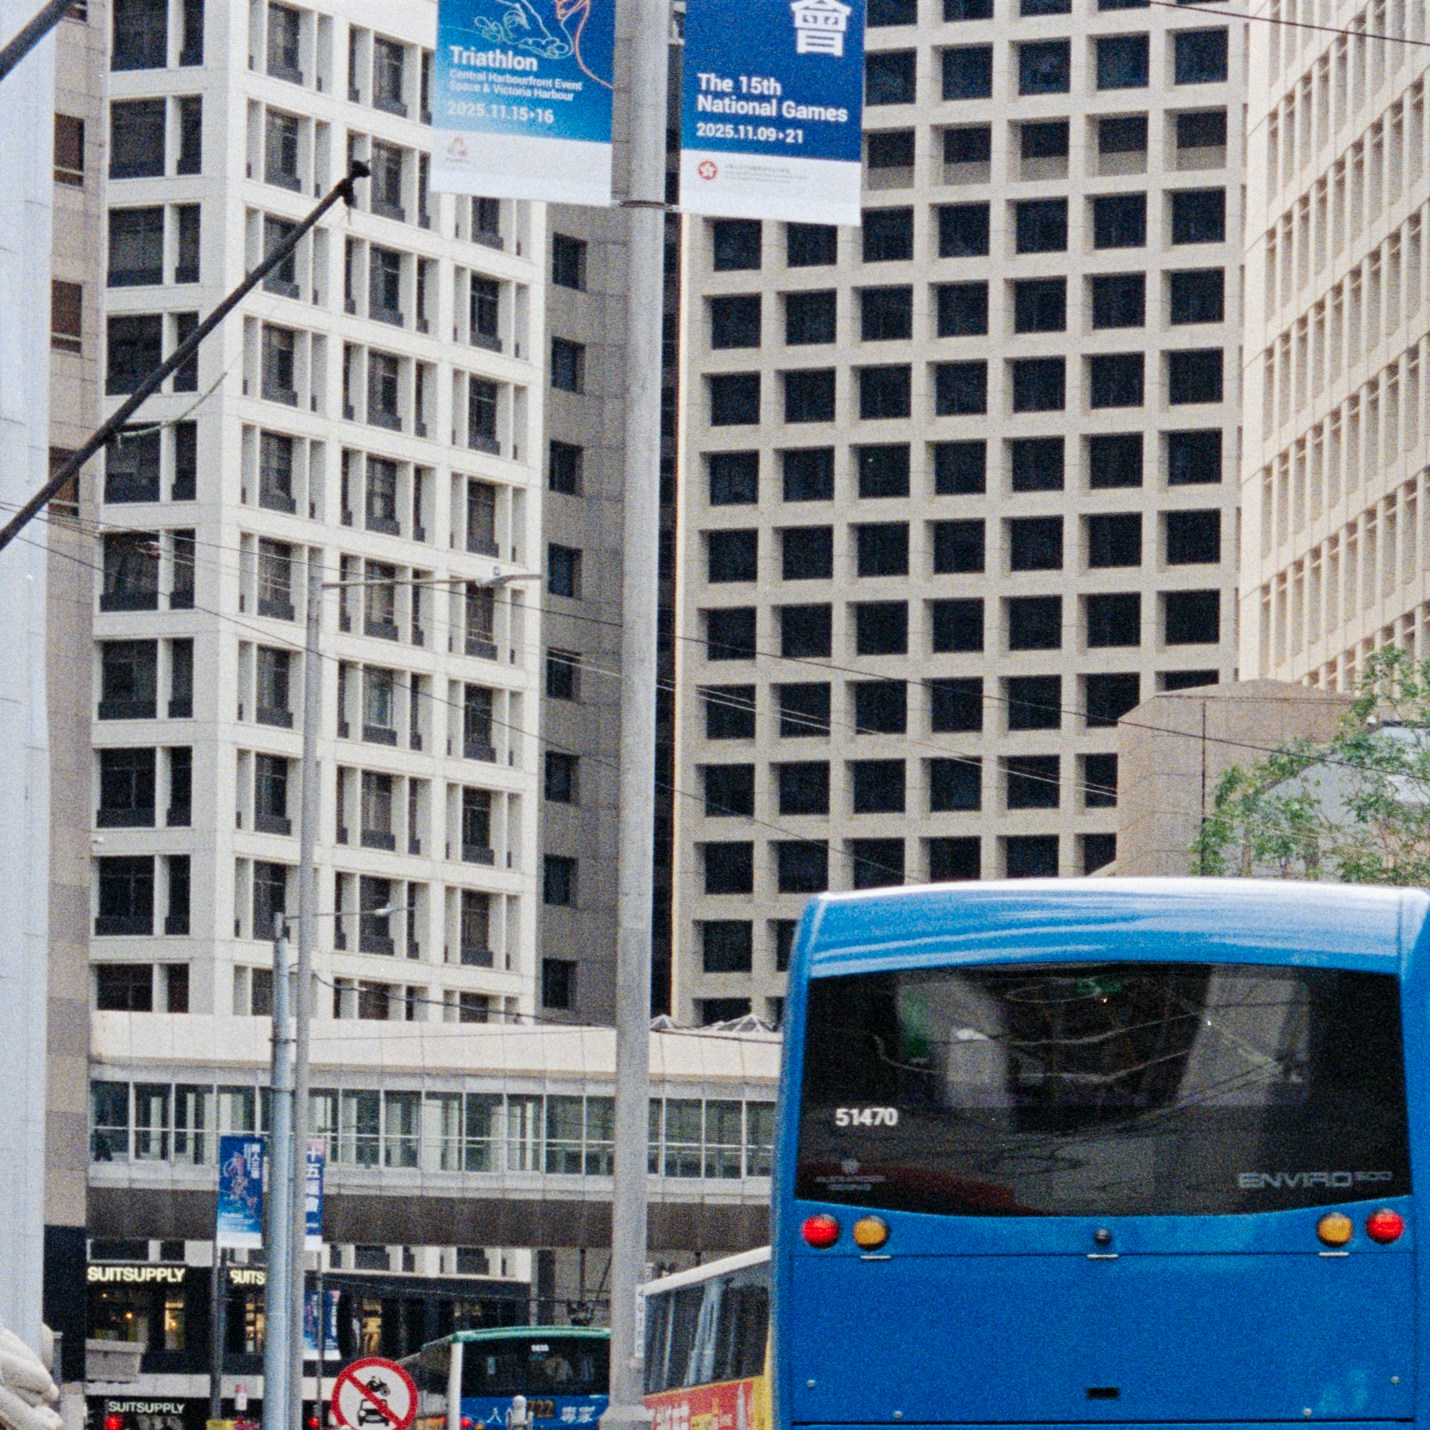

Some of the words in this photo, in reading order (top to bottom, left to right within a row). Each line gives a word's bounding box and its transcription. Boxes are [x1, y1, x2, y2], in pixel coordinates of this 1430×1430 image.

[450, 45, 538, 71] Triathlon
[450, 69, 486, 81] Central
[488, 72, 552, 88] Harbourfront
[555, 78, 582, 91] Event
[696, 73, 734, 92] The
[739, 76, 782, 96] 15th
[450, 81, 481, 93] Space
[482, 84, 490, 93] &
[493, 84, 531, 97] Victoria
[534, 88, 574, 101] Harbour
[697, 94, 777, 117] National
[782, 101, 848, 122] Games
[835, 1107, 898, 1126] 51470
[87, 1266, 185, 1283] SUITSUPPLY
[109, 1402, 185, 1413] SUITSUPPLY
